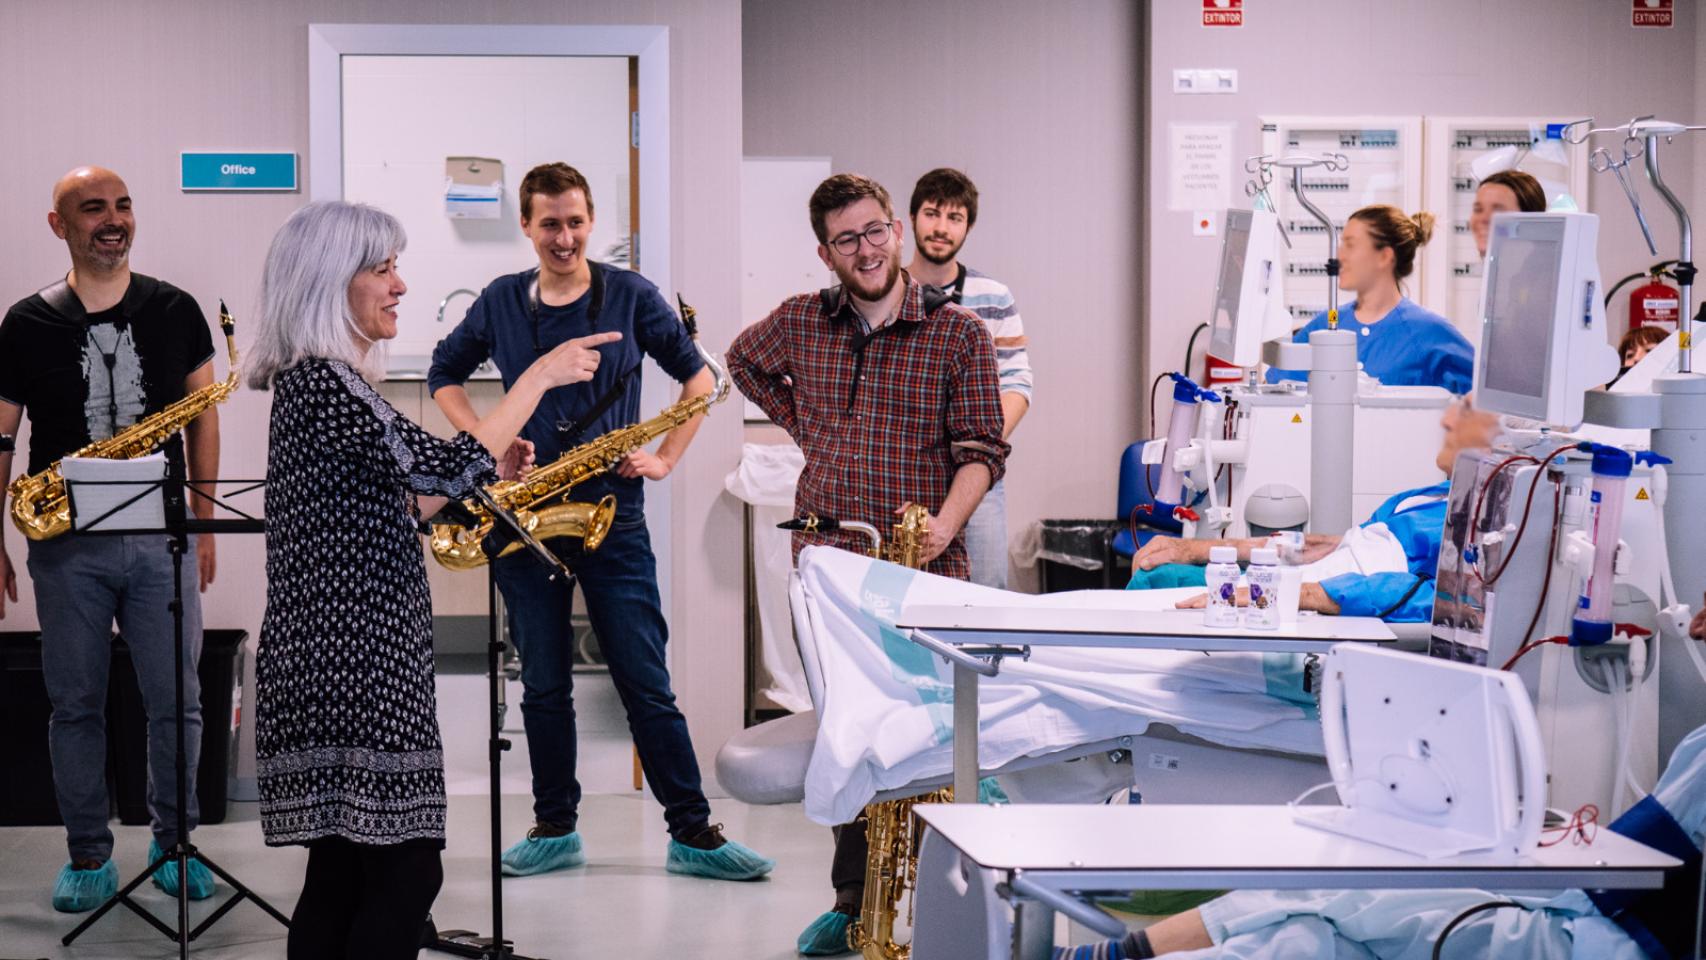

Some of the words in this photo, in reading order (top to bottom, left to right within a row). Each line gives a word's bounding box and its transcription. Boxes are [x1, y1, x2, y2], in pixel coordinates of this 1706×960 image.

[1204, 12, 1241, 23] EXTINTOR
[1634, 12, 1671, 23] EXTINTOR
[220, 163, 257, 175] Office
